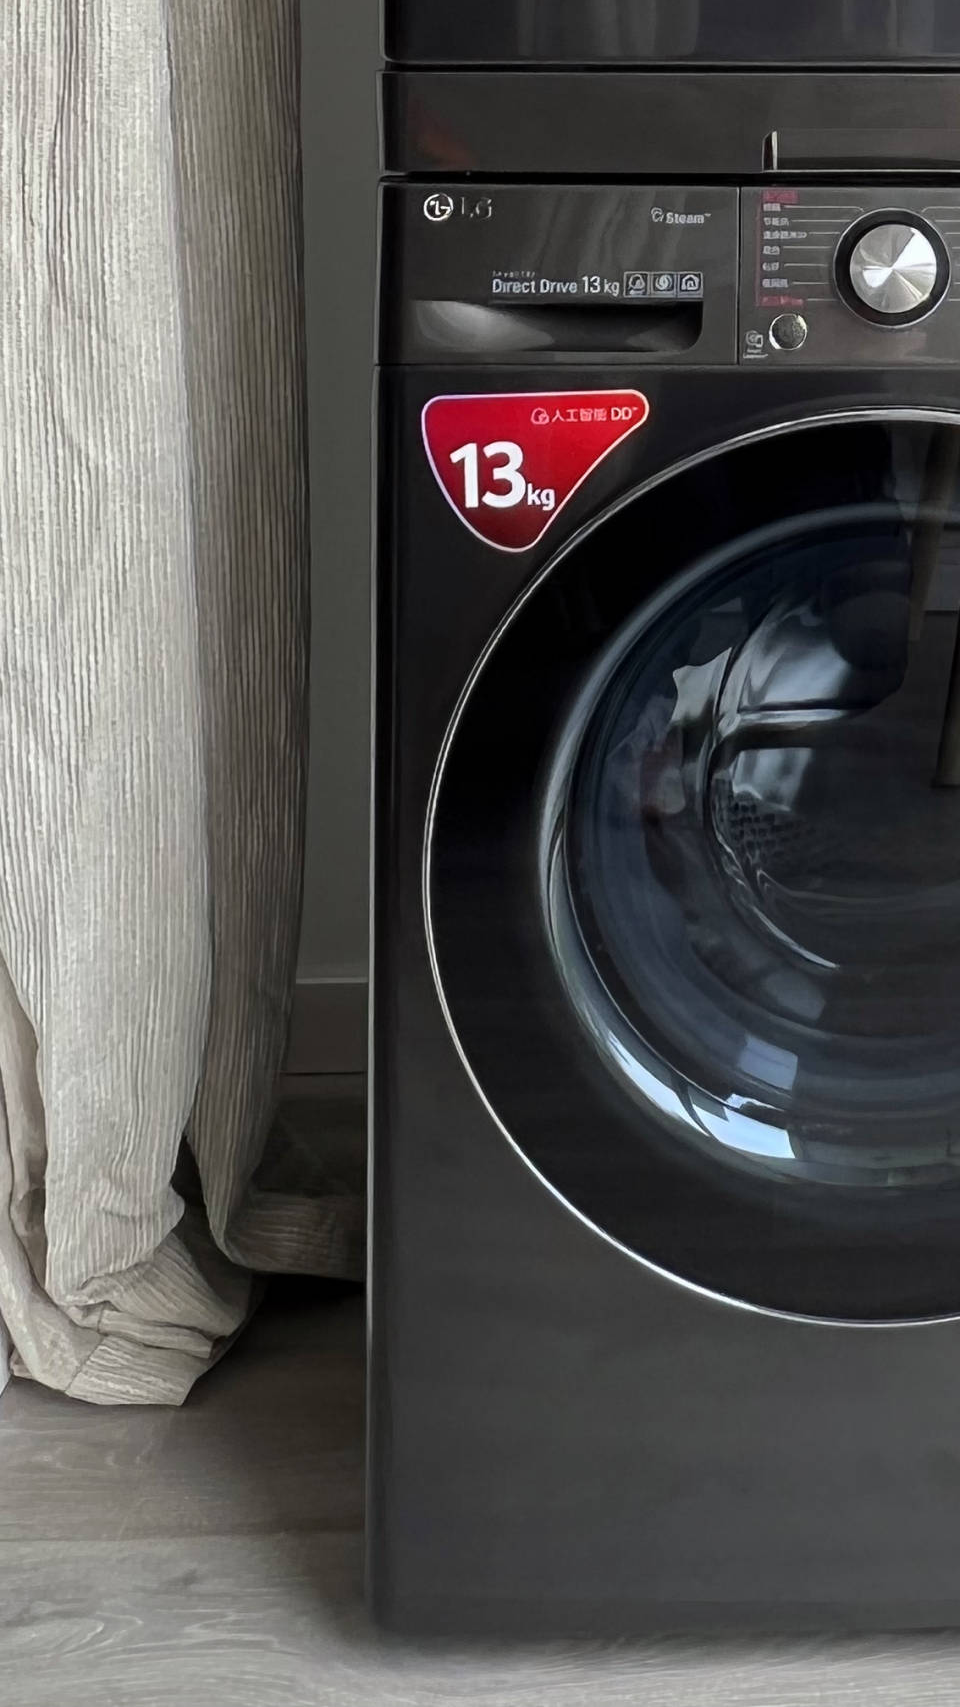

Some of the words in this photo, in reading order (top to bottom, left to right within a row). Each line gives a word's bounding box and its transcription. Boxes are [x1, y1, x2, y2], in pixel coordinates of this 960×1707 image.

[492, 278, 536, 294] Direct
[540, 278, 578, 294] Drive
[551, 408, 607, 422] 人工智能
